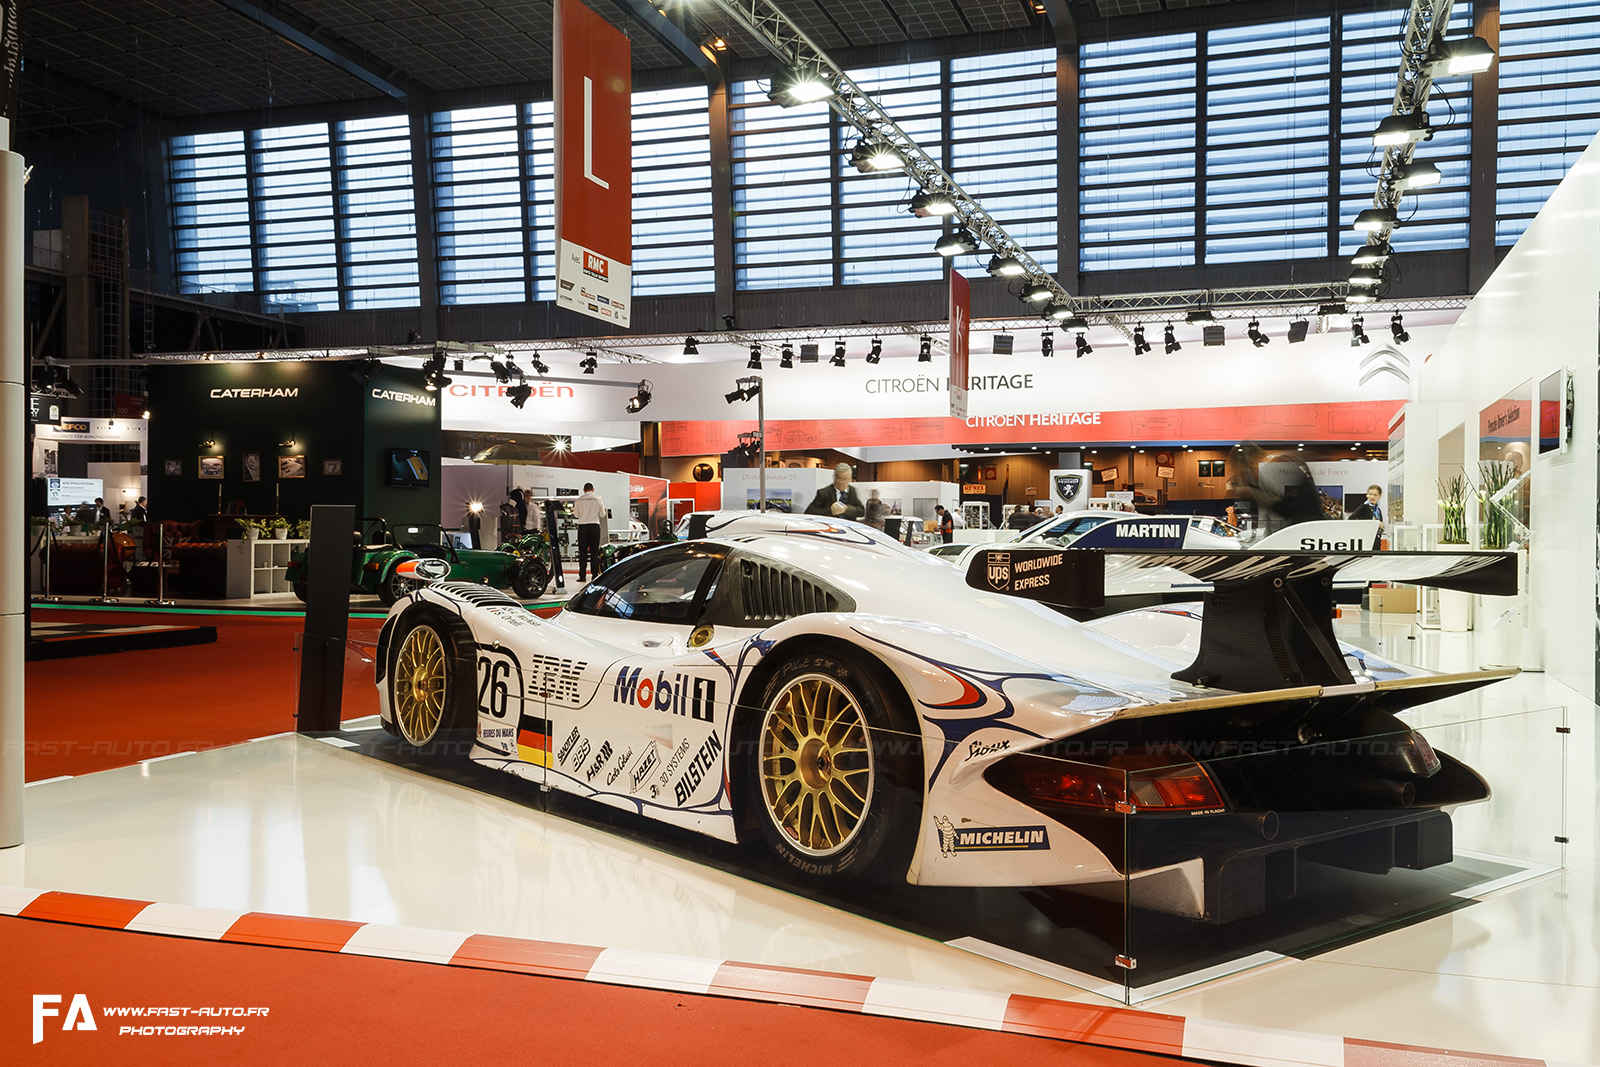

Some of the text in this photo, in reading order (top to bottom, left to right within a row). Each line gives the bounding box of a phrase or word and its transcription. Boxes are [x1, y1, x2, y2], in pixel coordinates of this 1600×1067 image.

[584, 75, 609, 190] L
[588, 254, 605, 274] RMC
[956, 305, 963, 354] K
[209, 387, 299, 399] CATERHAM
[865, 373, 1034, 394] CITROËN RITAGE
[371, 388, 437, 407] CATERHAM
[1029, 411, 1101, 427] HERITAGE
[742, 473, 751, 481] DS
[1327, 468, 1349, 476] France
[1116, 524, 1180, 538] MARTINI
[1300, 538, 1363, 551] Shell
[1014, 554, 1063, 574] WORLDWIDE
[989, 566, 1009, 584] ups
[1014, 574, 1050, 591] EXPRESS
[783, 657, 810, 677] Pilot
[477, 656, 510, 718] 26
[528, 654, 588, 703] IBM
[613, 666, 689, 716] Mobil
[495, 728, 501, 737] DU
[502, 728, 514, 737] MANS
[587, 753, 605, 782] H&R
[633, 749, 657, 787] HAZET
[660, 737, 690, 787] 3D SYSTEMS
[674, 729, 723, 807] BILSTEIN
[960, 830, 1044, 845] MICHELIN
[775, 843, 833, 875] MICHELIN
